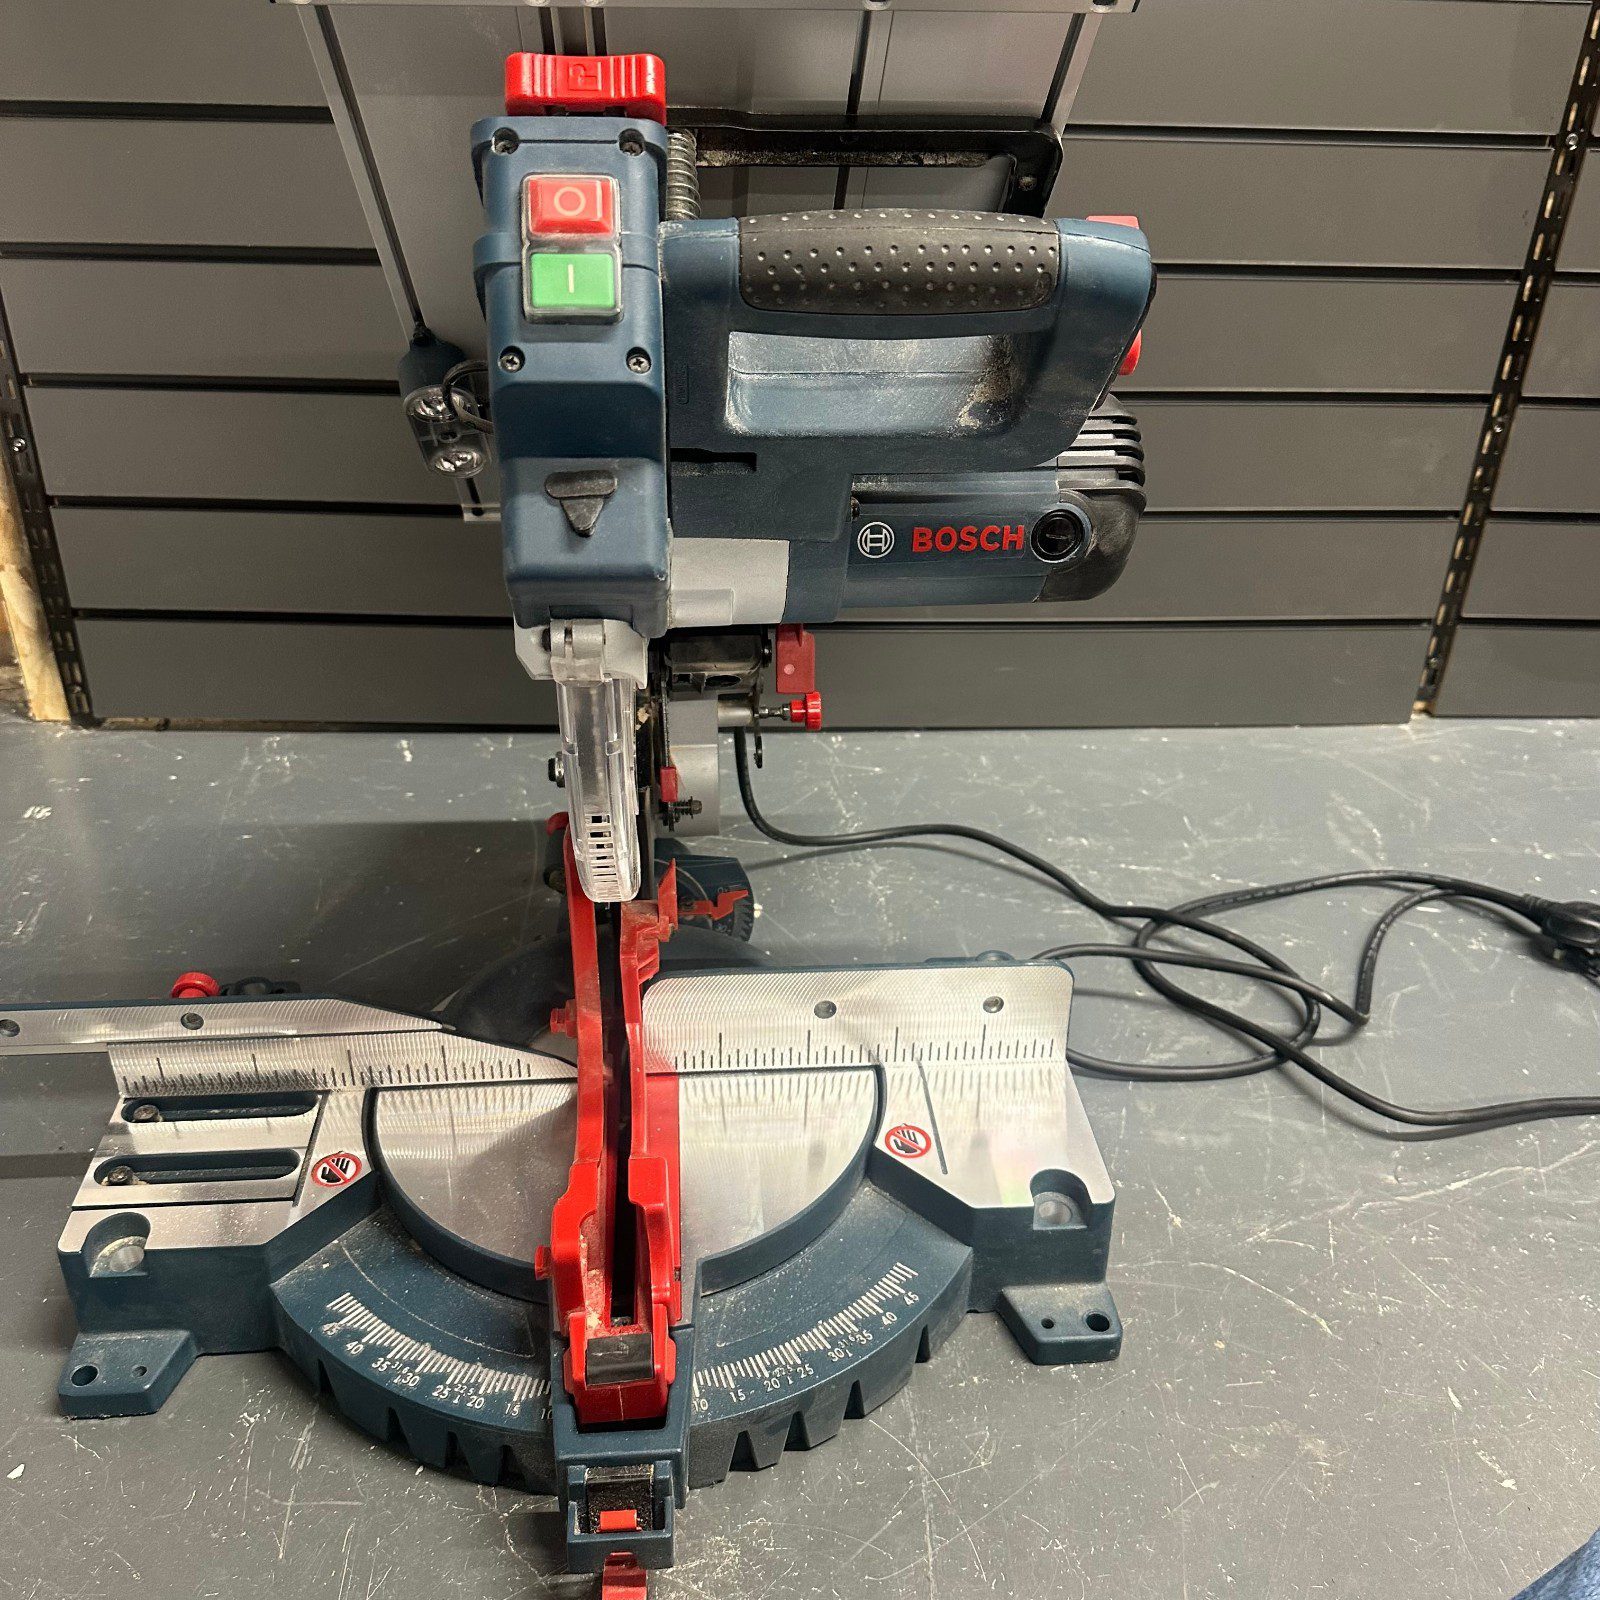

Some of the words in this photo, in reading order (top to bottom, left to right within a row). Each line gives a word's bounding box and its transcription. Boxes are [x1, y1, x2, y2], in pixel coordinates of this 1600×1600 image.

[912, 524, 1025, 552] BOSCH
[904, 1291, 919, 1306] 45
[882, 1311, 898, 1326] 40
[855, 1329, 873, 1345] 35
[346, 1341, 364, 1355] 40
[828, 1347, 845, 1362] 30
[372, 1357, 391, 1371] 35
[797, 1363, 814, 1379] 25
[401, 1373, 420, 1387] 30
[763, 1377, 781, 1392] 20
[432, 1384, 452, 1398] 25
[730, 1388, 746, 1403] 15
[466, 1395, 485, 1409] 20
[505, 1403, 521, 1416] 15
[693, 1398, 709, 1412] 10
